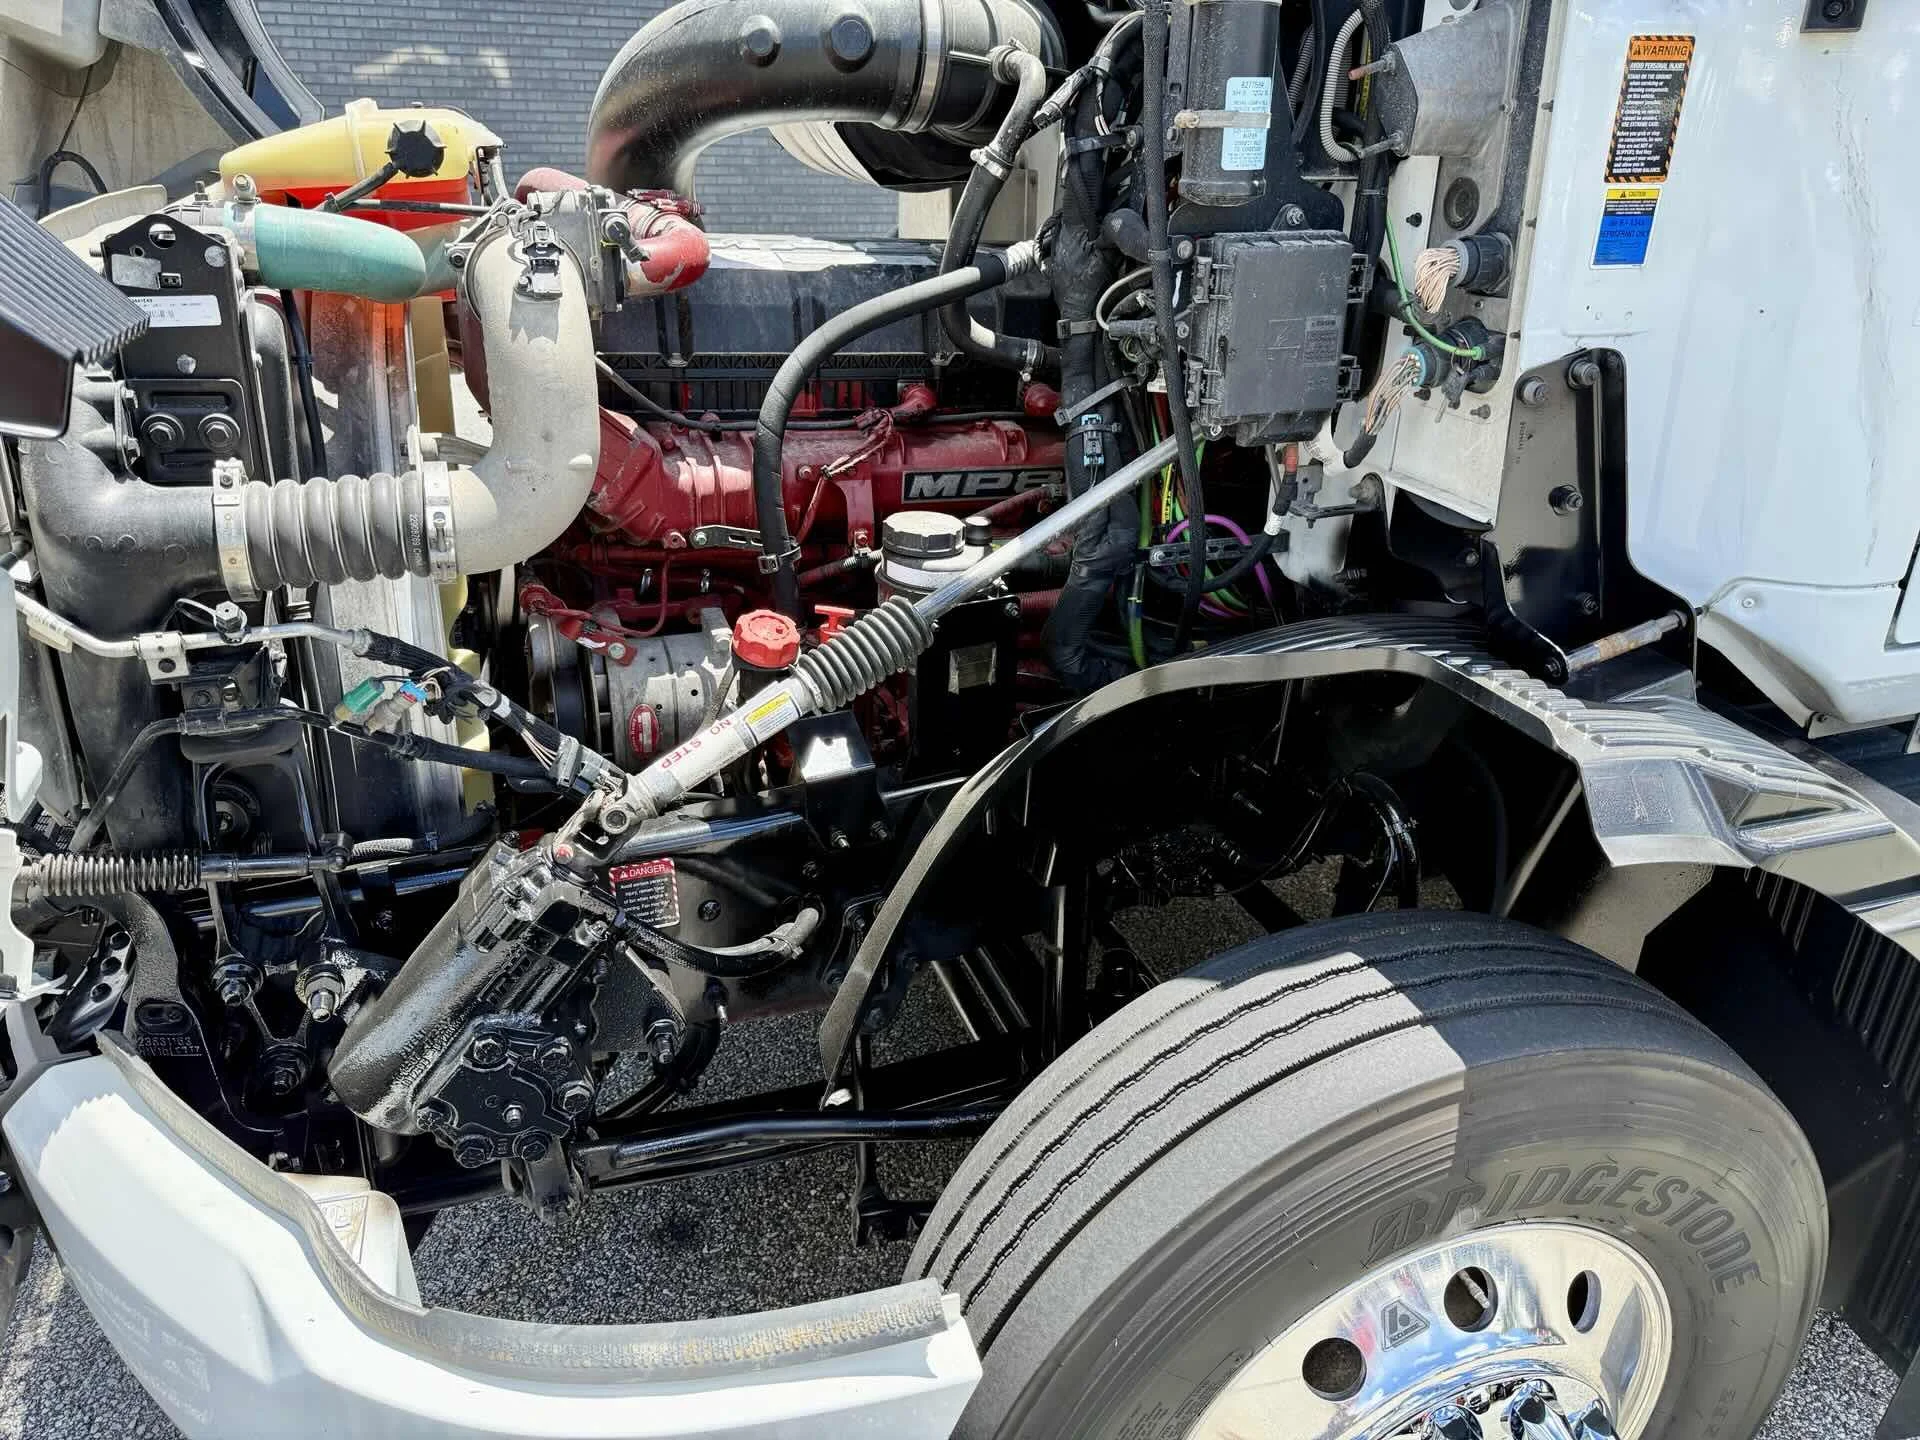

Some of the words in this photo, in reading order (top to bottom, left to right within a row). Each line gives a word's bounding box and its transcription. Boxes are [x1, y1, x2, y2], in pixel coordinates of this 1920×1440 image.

[1642, 45, 1688, 56] WARNING
[908, 470, 1064, 498] MP8
[710, 719, 732, 735] NO
[661, 740, 702, 769] STEP
[629, 864, 665, 877] DANGER
[1366, 1162, 1761, 1293] BRIDGESTONE
